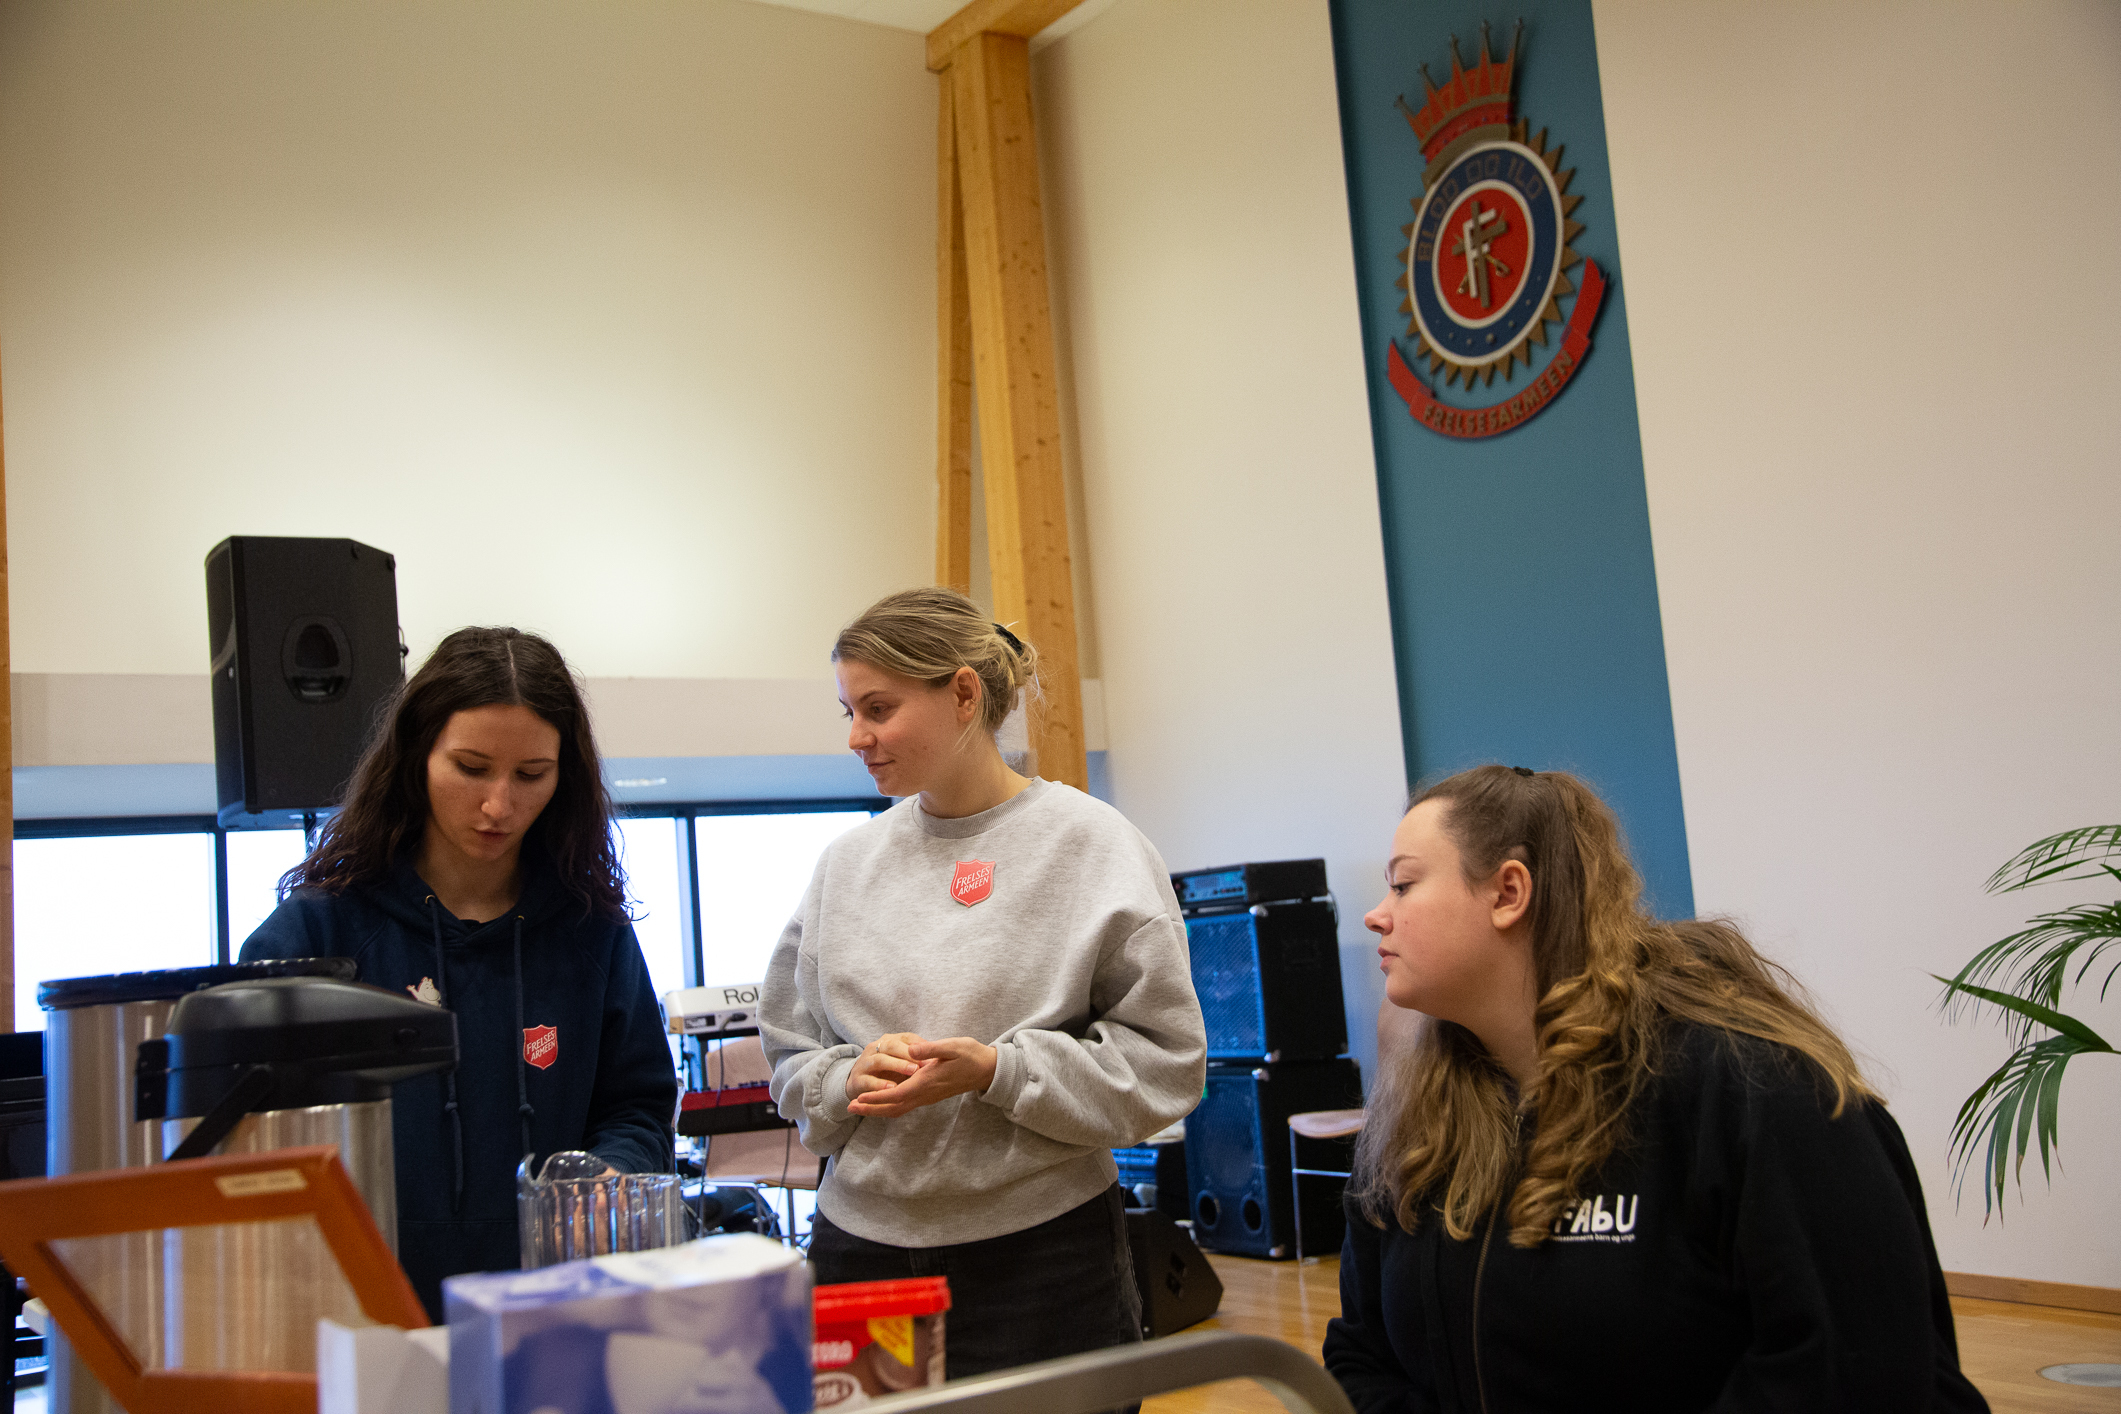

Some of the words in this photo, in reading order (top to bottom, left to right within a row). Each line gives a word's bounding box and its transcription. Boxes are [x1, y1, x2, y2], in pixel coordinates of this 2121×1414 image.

[1417, 178, 1460, 261] BLOD
[1465, 154, 1501, 183] OG
[1507, 157, 1544, 200] ILD
[1423, 350, 1573, 435] FRELSESARMEEN
[955, 866, 990, 889] FRELSES
[957, 876, 989, 897] ARMEEN
[723, 986, 761, 1005] Rol
[526, 1030, 555, 1055] FRELSES
[530, 1040, 555, 1062] ARMEEN
